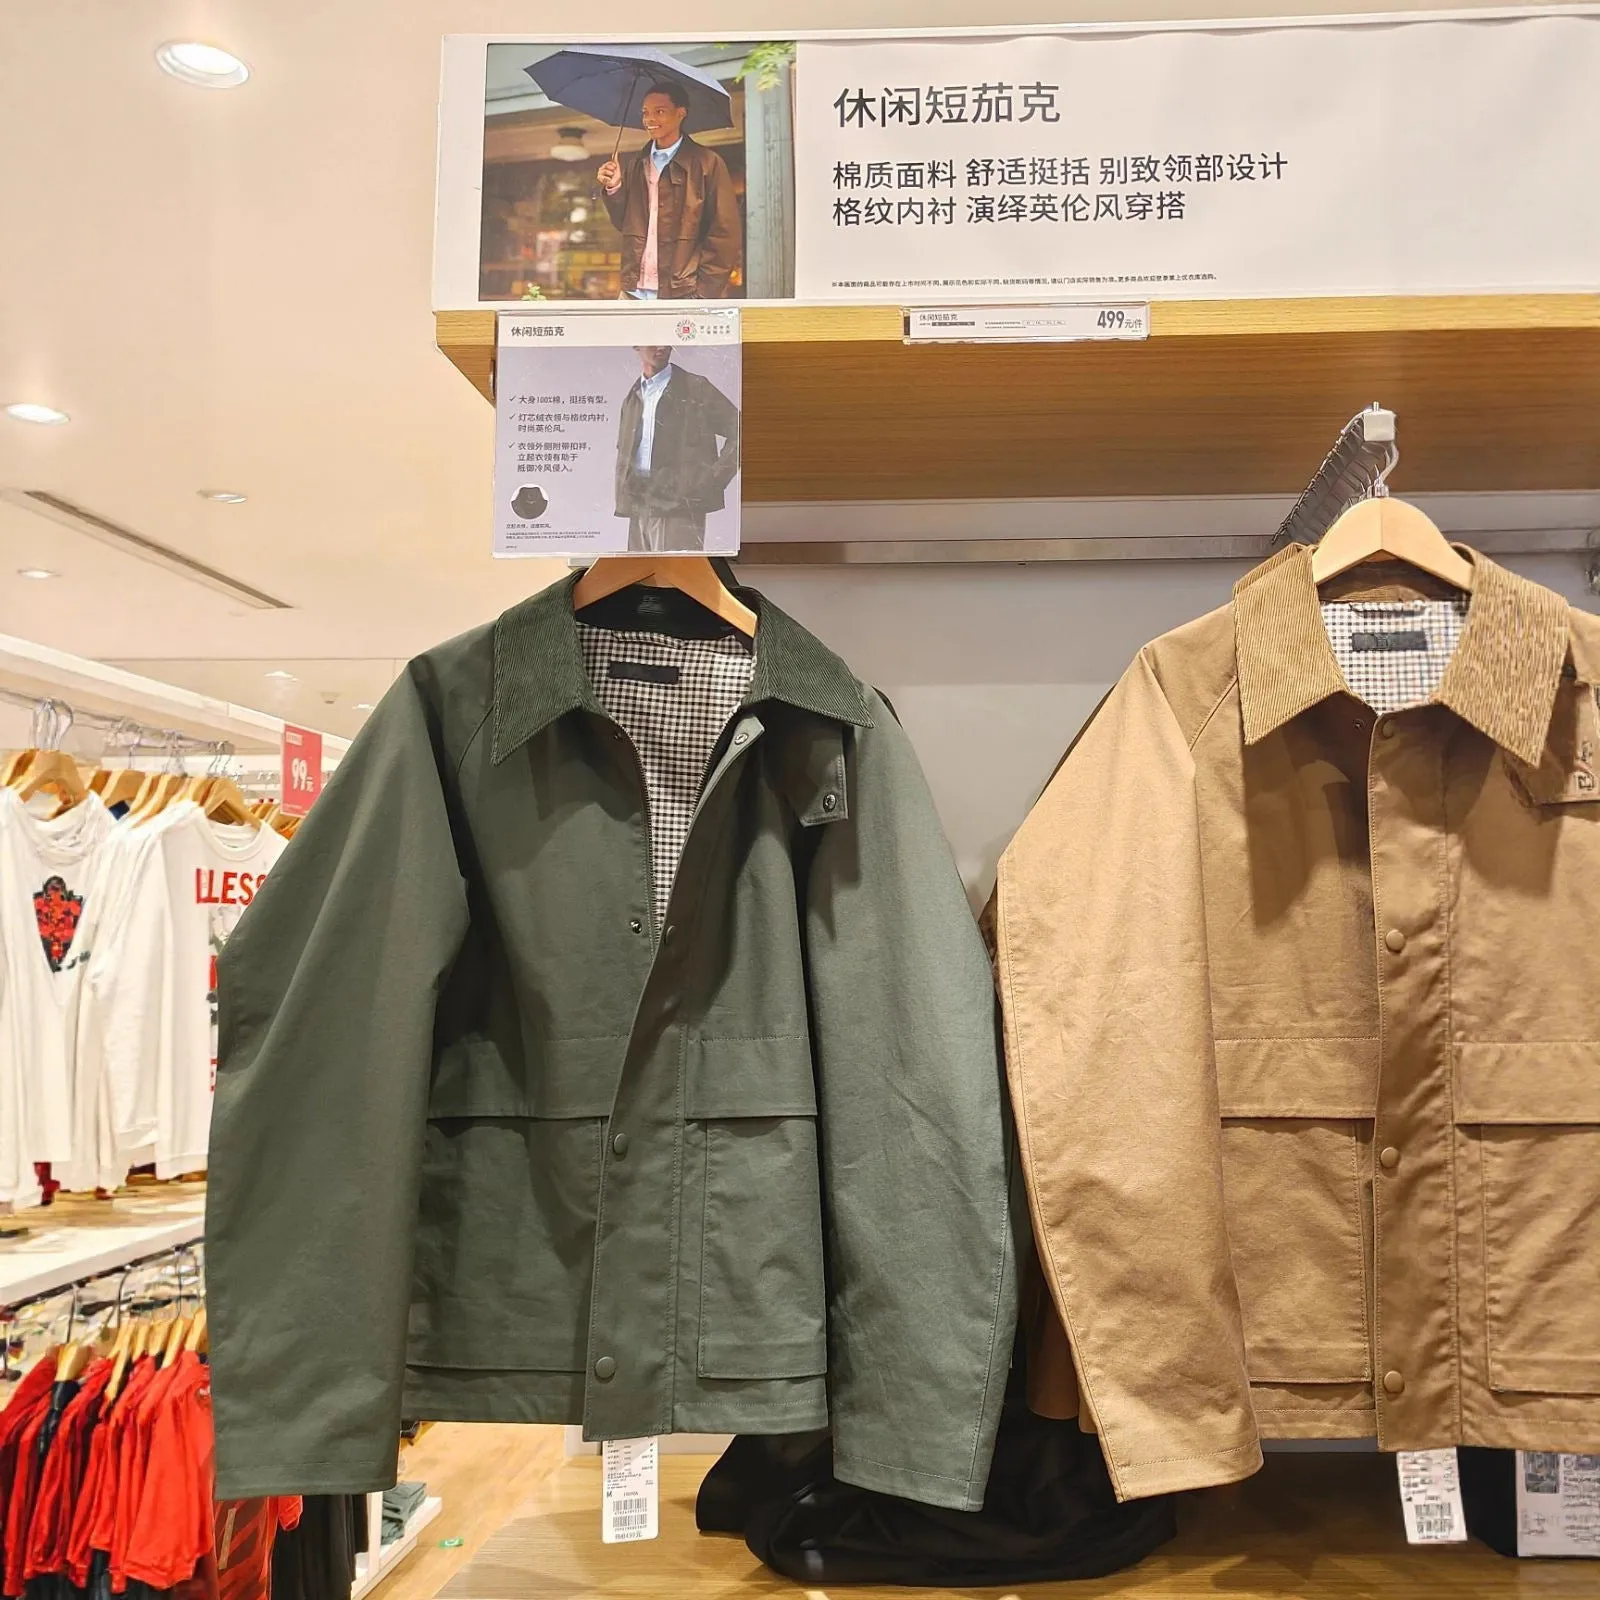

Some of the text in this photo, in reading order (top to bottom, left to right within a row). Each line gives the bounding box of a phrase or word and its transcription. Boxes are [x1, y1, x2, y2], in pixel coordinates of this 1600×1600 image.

[833, 81, 1061, 128] 休闲短茄克
[832, 152, 1289, 191] 棉质面料 舒适挺括 别致领部设计
[832, 191, 1186, 227] 格纹内衬 演绎英伦风穿搭
[510, 326, 565, 337] 休闲短茄克
